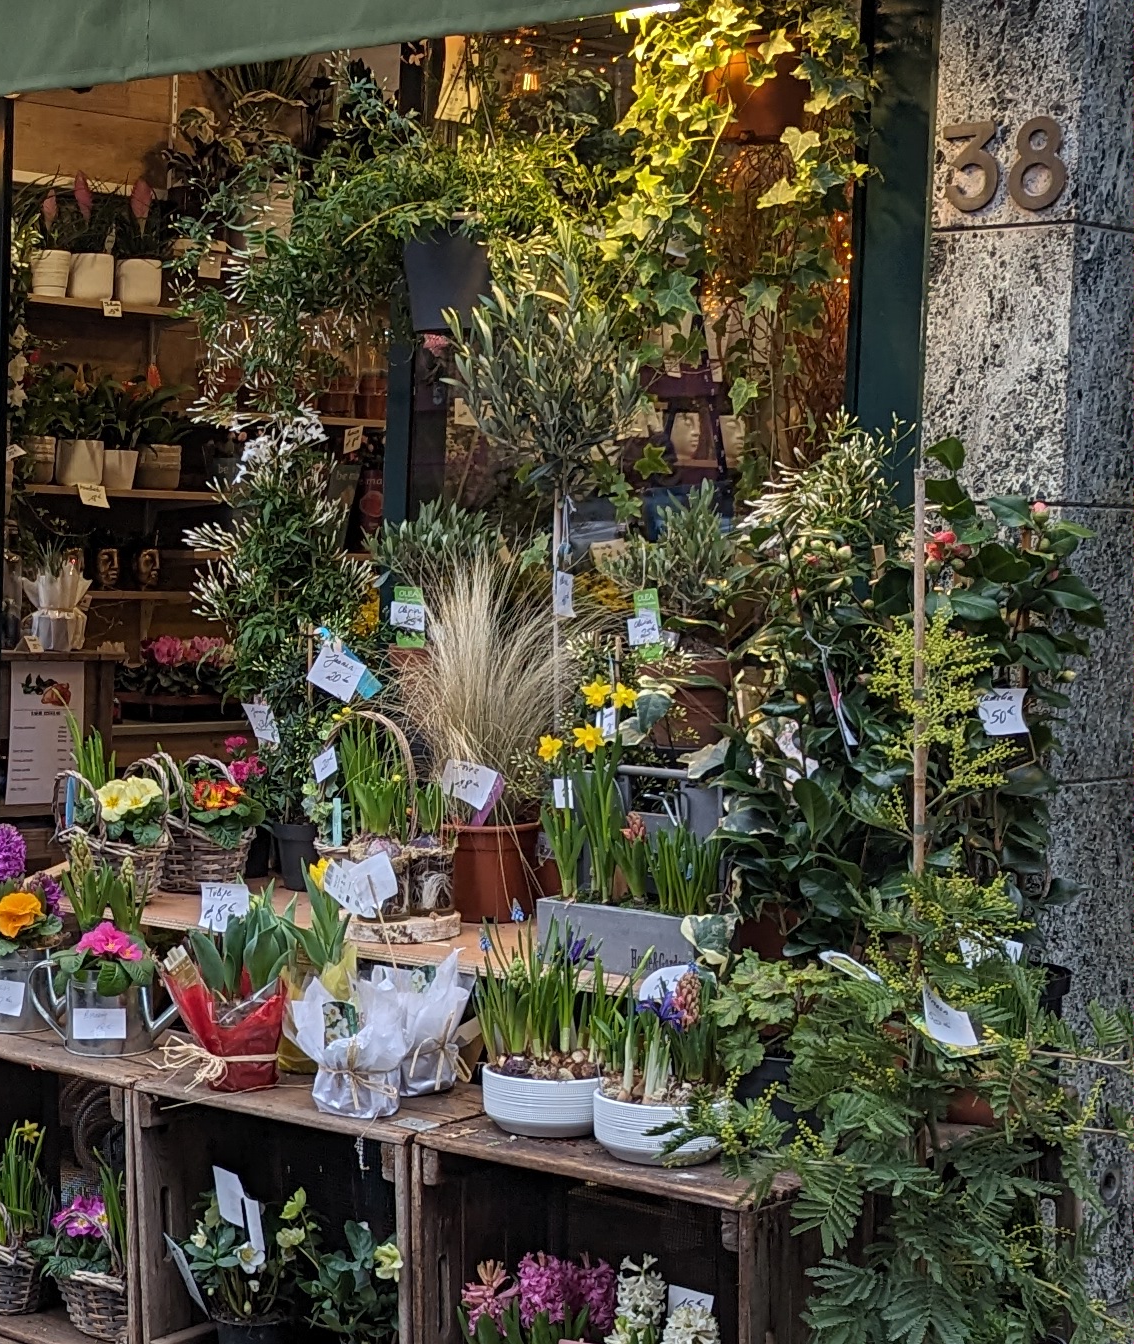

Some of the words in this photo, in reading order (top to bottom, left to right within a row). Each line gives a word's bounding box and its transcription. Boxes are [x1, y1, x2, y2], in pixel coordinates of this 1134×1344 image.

[941, 115, 1066, 213] 38
[399, 590, 418, 598] OLEA
[637, 593, 655, 601] OLEA
[989, 705, 1016, 725] 50€
